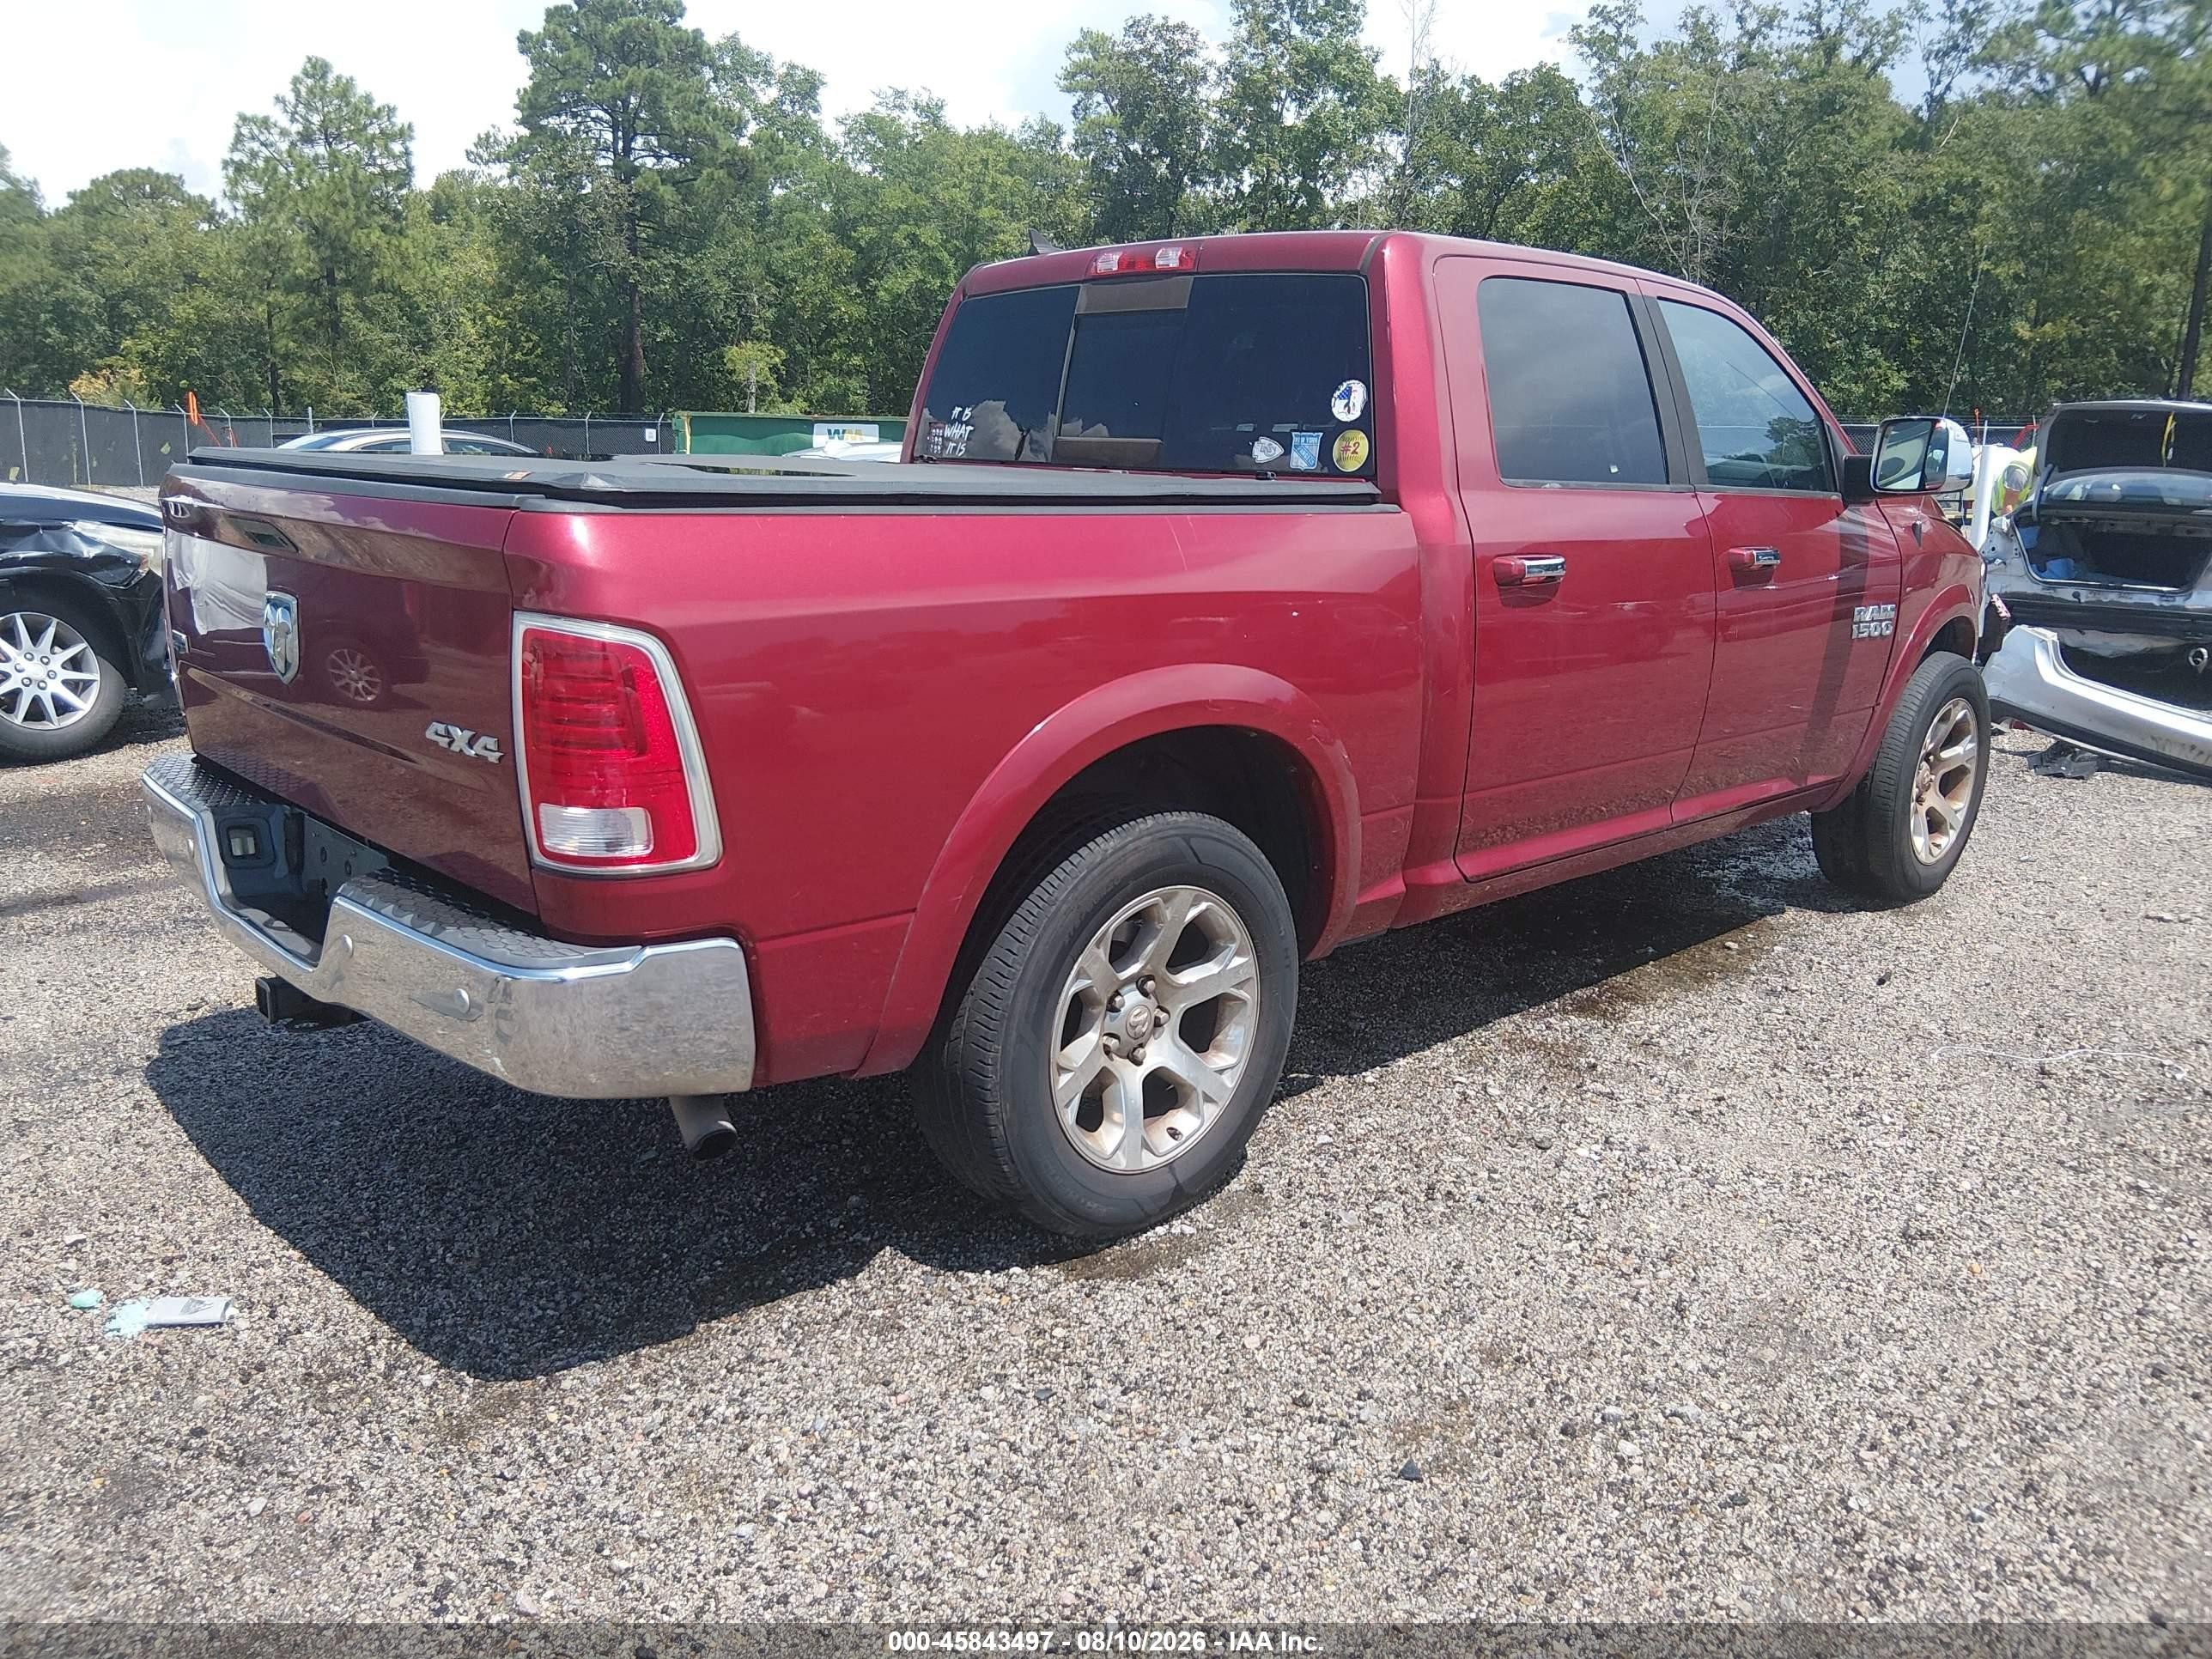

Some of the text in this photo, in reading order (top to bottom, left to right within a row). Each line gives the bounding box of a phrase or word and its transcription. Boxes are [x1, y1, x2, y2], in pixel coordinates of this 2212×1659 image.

[951, 406, 973, 421] IT IS
[945, 422, 975, 441] WHAT
[946, 441, 967, 456] IT IS
[1340, 441, 1360, 455] #2
[1854, 604, 1896, 622] RAM
[1852, 621, 1893, 639] 1500
[426, 722, 505, 763] 4X4
